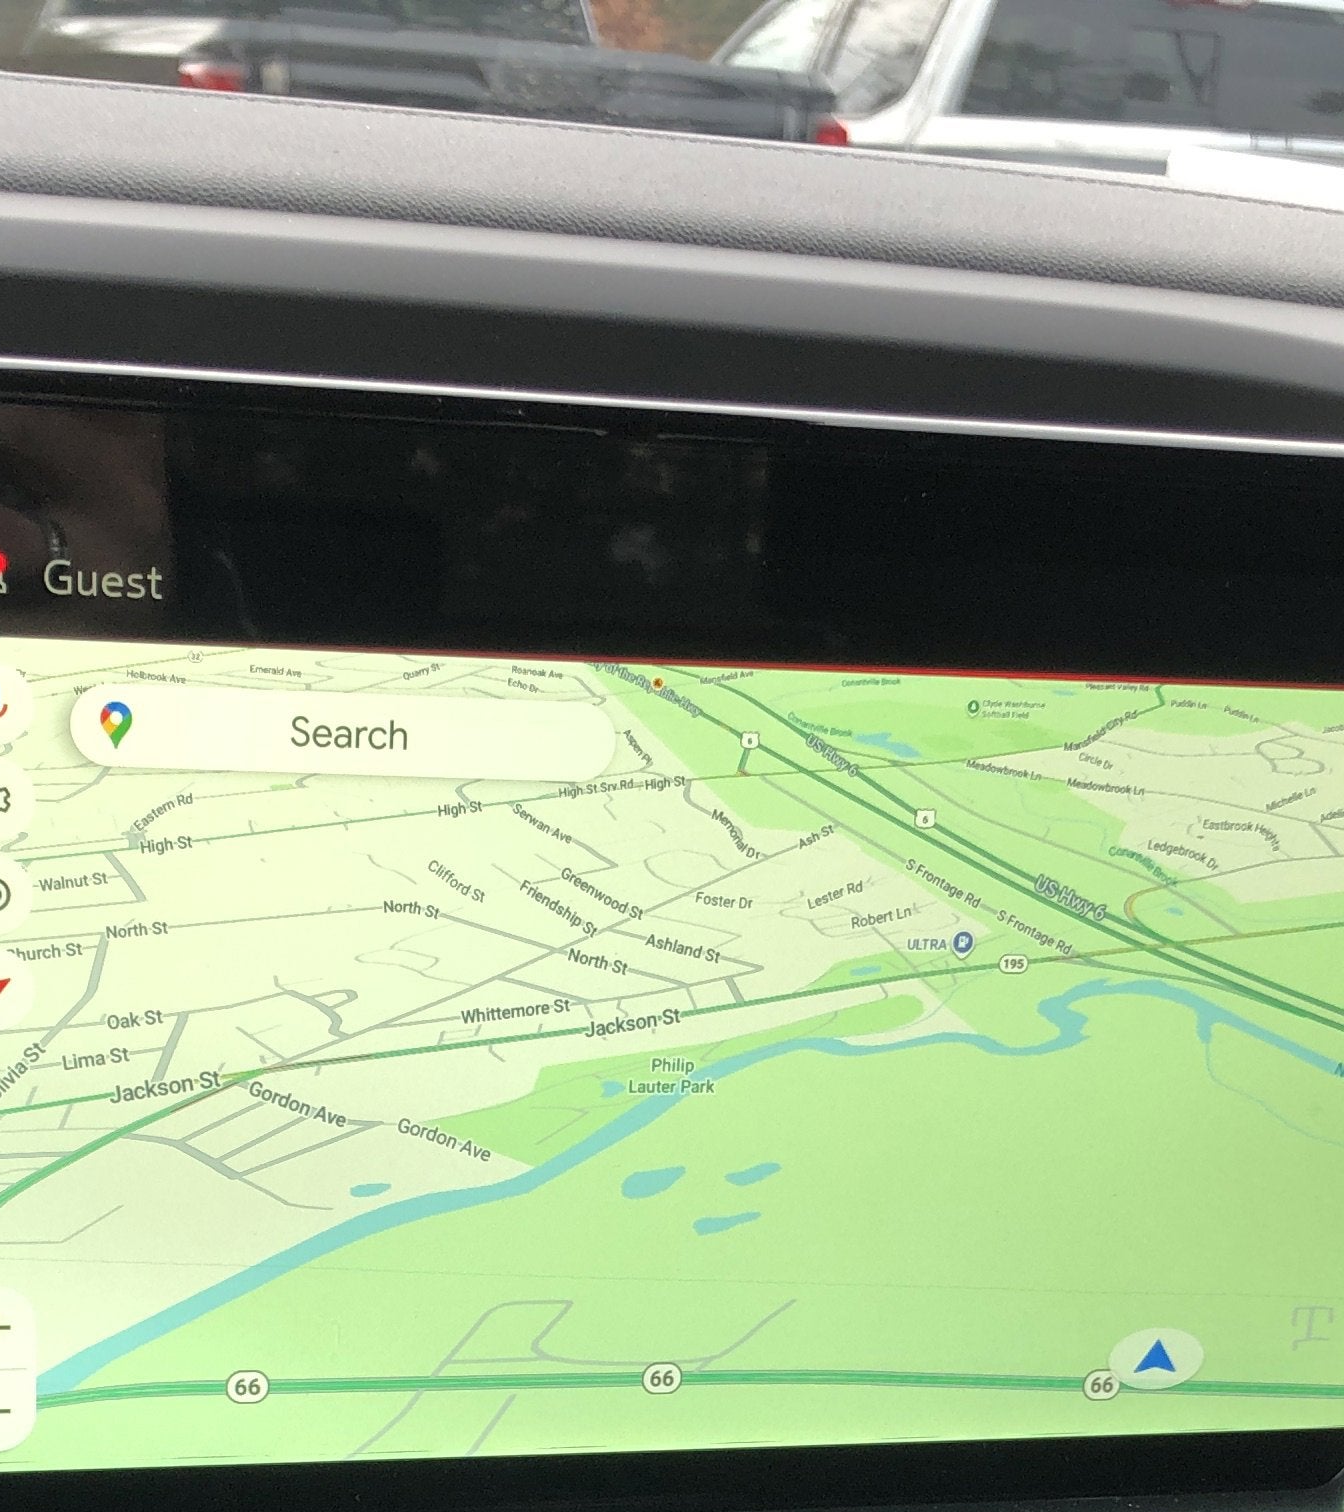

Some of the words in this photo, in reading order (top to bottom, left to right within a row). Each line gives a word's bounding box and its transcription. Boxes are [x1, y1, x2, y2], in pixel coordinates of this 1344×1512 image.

[43, 559, 163, 600] Guest
[168, 673, 187, 685] Ave
[249, 664, 284, 676] Emerald
[285, 667, 303, 679] Ave
[402, 665, 430, 681] Quarry
[430, 662, 442, 673] St
[547, 668, 564, 680] Ave
[507, 677, 529, 691] Echo
[529, 681, 540, 694] Dr
[1124, 709, 1139, 722] Rd
[290, 715, 408, 750] Search
[806, 734, 824, 755] US
[823, 746, 849, 772] Hwy
[965, 758, 1028, 781] Meadowbrook
[1028, 768, 1044, 782] Ln
[1102, 759, 1114, 771] Dr
[557, 783, 585, 799] High
[585, 782, 599, 795] St
[599, 781, 619, 794] Srv
[619, 779, 635, 792] Rd
[644, 776, 673, 792] High
[673, 775, 687, 788] St
[1066, 777, 1133, 795] Meadowbrook
[1133, 786, 1146, 797] Ln
[133, 799, 176, 832] Eastern
[175, 792, 194, 808] Rd
[437, 804, 467, 819] High
[469, 801, 483, 814] St
[511, 803, 551, 836] Serwan
[550, 824, 573, 845] Ave
[710, 808, 750, 855] Memorial
[745, 843, 761, 860] Dr
[1202, 818, 1253, 833] Eastbrook
[138, 838, 174, 856] High
[176, 835, 193, 850] St
[797, 830, 819, 850] Ash
[818, 824, 835, 840] St
[1147, 838, 1207, 865] Ledgebrook
[1205, 857, 1220, 872] Dr
[38, 875, 89, 892] Walnut
[91, 871, 109, 885] St
[427, 859, 473, 894] Clifford
[470, 886, 486, 903] St
[905, 858, 916, 871] S
[914, 863, 964, 903] Frontage
[962, 891, 982, 909] Rd
[560, 867, 628, 916] Greenwood
[626, 905, 644, 921] St
[695, 891, 738, 909] Foster
[739, 895, 754, 910] Dr
[807, 884, 845, 910] Lester
[846, 880, 864, 895] Rd
[1033, 873, 1059, 899] US
[1054, 885, 1092, 920] Hwy
[1090, 903, 1108, 922] 6
[383, 900, 421, 916] North
[423, 904, 440, 920] St
[518, 879, 584, 928] Friendship
[582, 921, 598, 938] St
[850, 911, 893, 930] Robert
[895, 906, 913, 922] Ln
[105, 923, 149, 940] North
[151, 921, 169, 936] St
[996, 909, 1008, 923] S
[1007, 913, 1057, 953] Frontage
[1055, 938, 1074, 956] Rd
[65, 942, 84, 957] St
[644, 933, 704, 960] Ashland
[704, 947, 722, 964] St
[906, 938, 948, 951] ULTRA
[567, 947, 611, 971] North
[611, 959, 629, 977] St
[1003, 958, 1025, 970] 195
[106, 1014, 141, 1031] Oak
[144, 1010, 164, 1026] St
[460, 1001, 551, 1025] Whittemore
[553, 998, 571, 1014] St
[584, 1013, 658, 1039] Jackson
[661, 1008, 681, 1026] St
[22, 1041, 47, 1065] St
[60, 1052, 106, 1072] Lima
[109, 1048, 131, 1065] St
[651, 1058, 695, 1076] Philip
[109, 1076, 197, 1104] Jackson
[199, 1070, 222, 1089] St
[627, 1079, 677, 1095] Lauter
[680, 1079, 715, 1095] Park
[248, 1080, 311, 1117] Gordon
[312, 1105, 347, 1128] Ave
[397, 1117, 458, 1150] Gordon
[458, 1139, 492, 1162] Ave
[234, 1377, 262, 1397] 66
[649, 1369, 675, 1388] 66
[1089, 1375, 1115, 1395] 66
